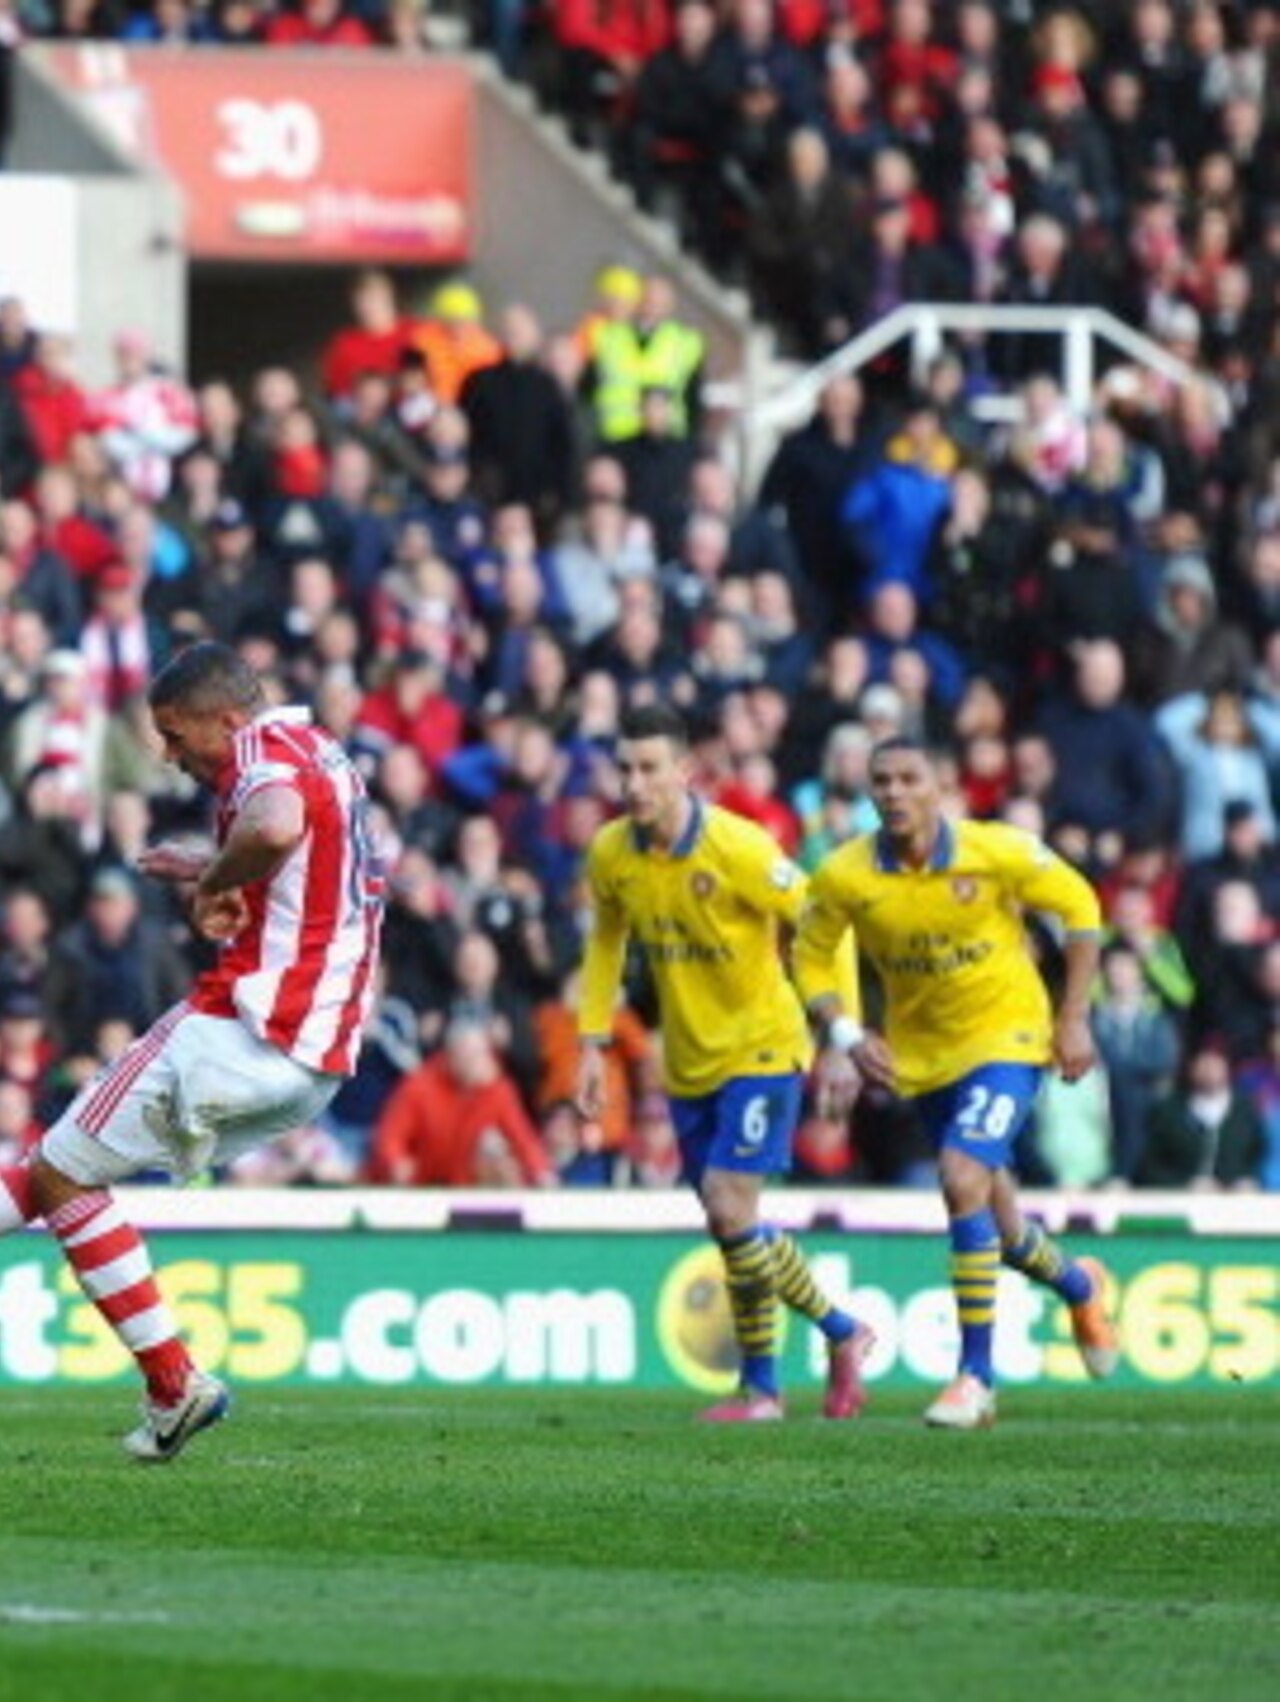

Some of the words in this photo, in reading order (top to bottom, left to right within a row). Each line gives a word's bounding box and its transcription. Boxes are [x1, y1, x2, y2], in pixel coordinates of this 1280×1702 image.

[214, 101, 321, 179] 30
[743, 1094, 768, 1144] 6
[956, 1085, 1015, 1139] 28
